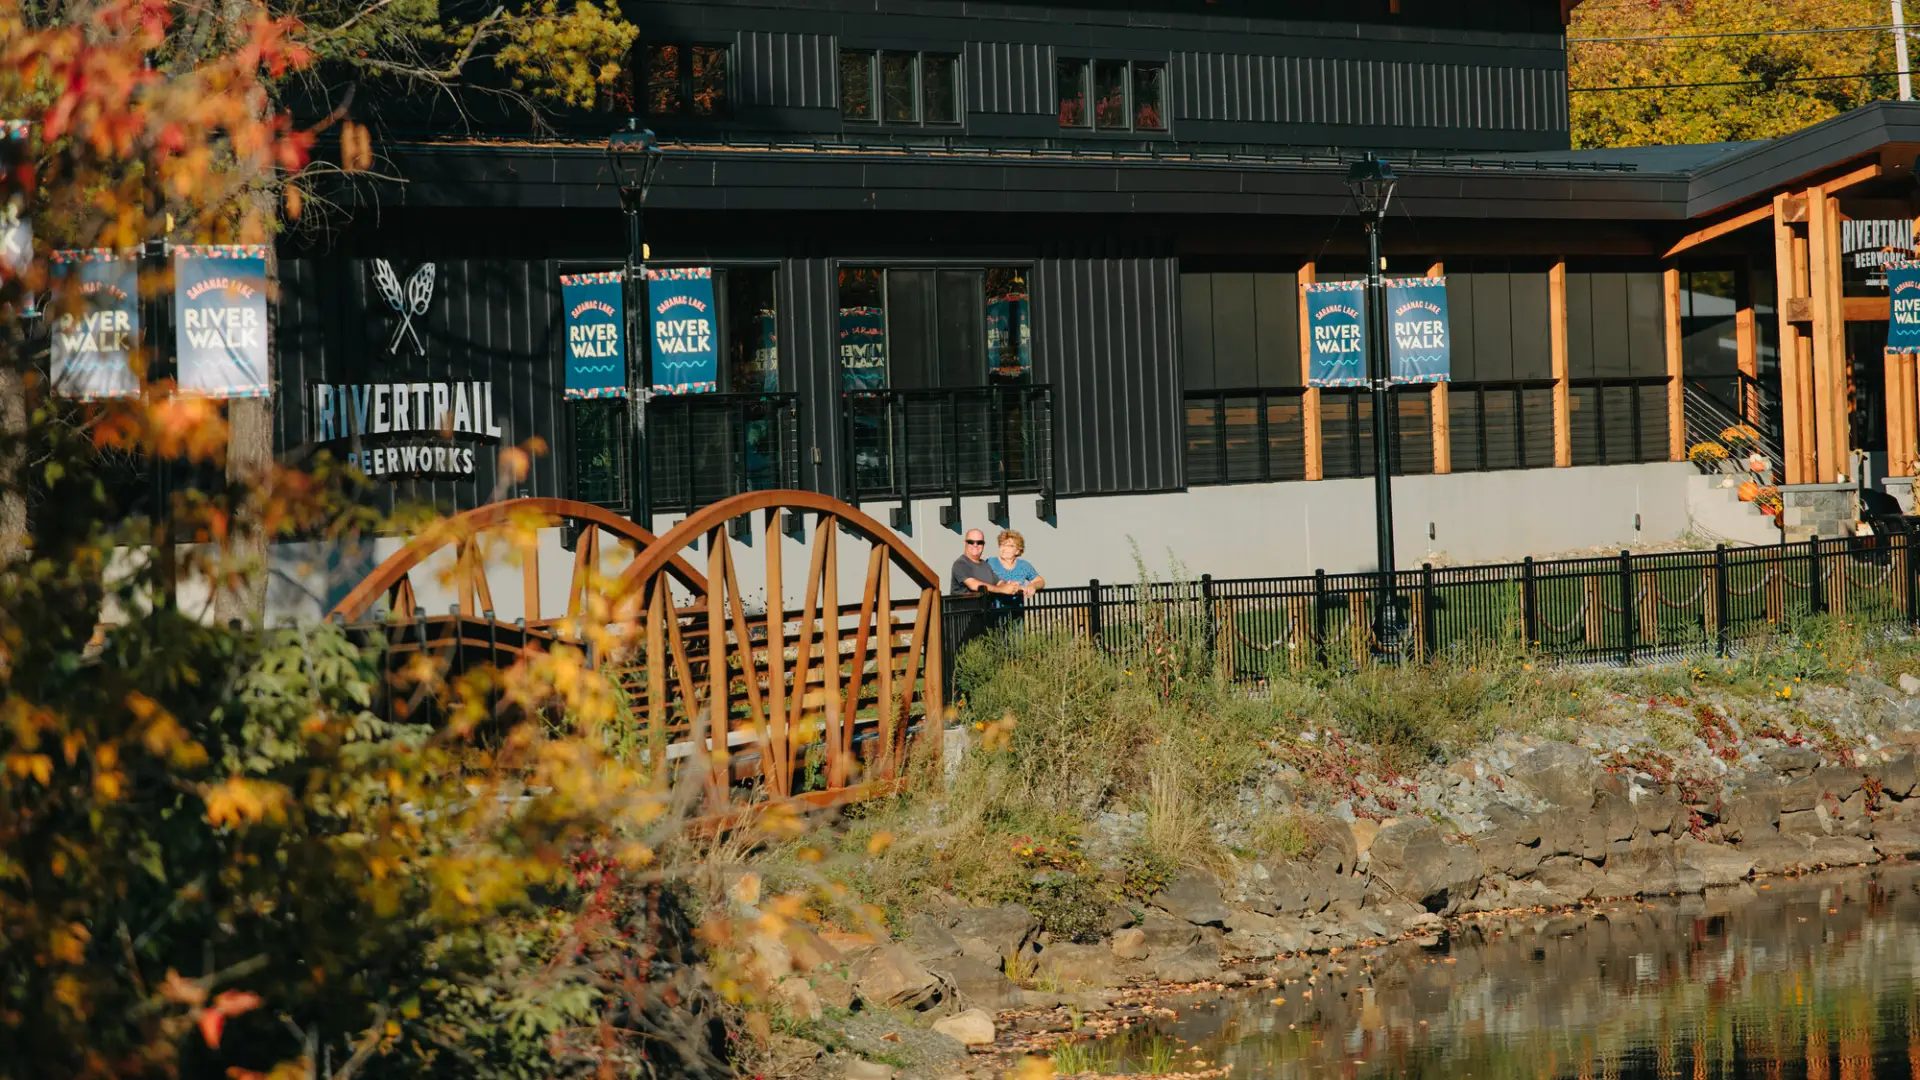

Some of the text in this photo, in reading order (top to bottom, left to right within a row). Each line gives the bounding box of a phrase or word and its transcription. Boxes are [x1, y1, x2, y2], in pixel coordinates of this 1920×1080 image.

[1842, 219, 1916, 254] RIVERTRAIL
[186, 277, 229, 300] SARANAC
[571, 300, 616, 319] SARANAC LAKE
[657, 295, 707, 314] SARANAC LAKE
[1315, 304, 1359, 320] SARANAC LAKE
[1395, 300, 1442, 316] SARANAC LAKE
[1894, 298, 1920, 312] RIVE
[184, 307, 260, 328] RIVER
[1894, 311, 1920, 324] WAL
[570, 323, 618, 342] RIVER
[656, 319, 711, 338] RIVER
[1314, 324, 1361, 340] RIVER
[1394, 320, 1445, 336] RIVER
[60, 332, 130, 352] WALK
[185, 328, 259, 349] WALK
[657, 336, 711, 354] WALK
[1316, 338, 1361, 353] WALK
[1395, 334, 1445, 350] WALK
[570, 340, 618, 358] WALK
[315, 381, 501, 442] RIVERTRAIL
